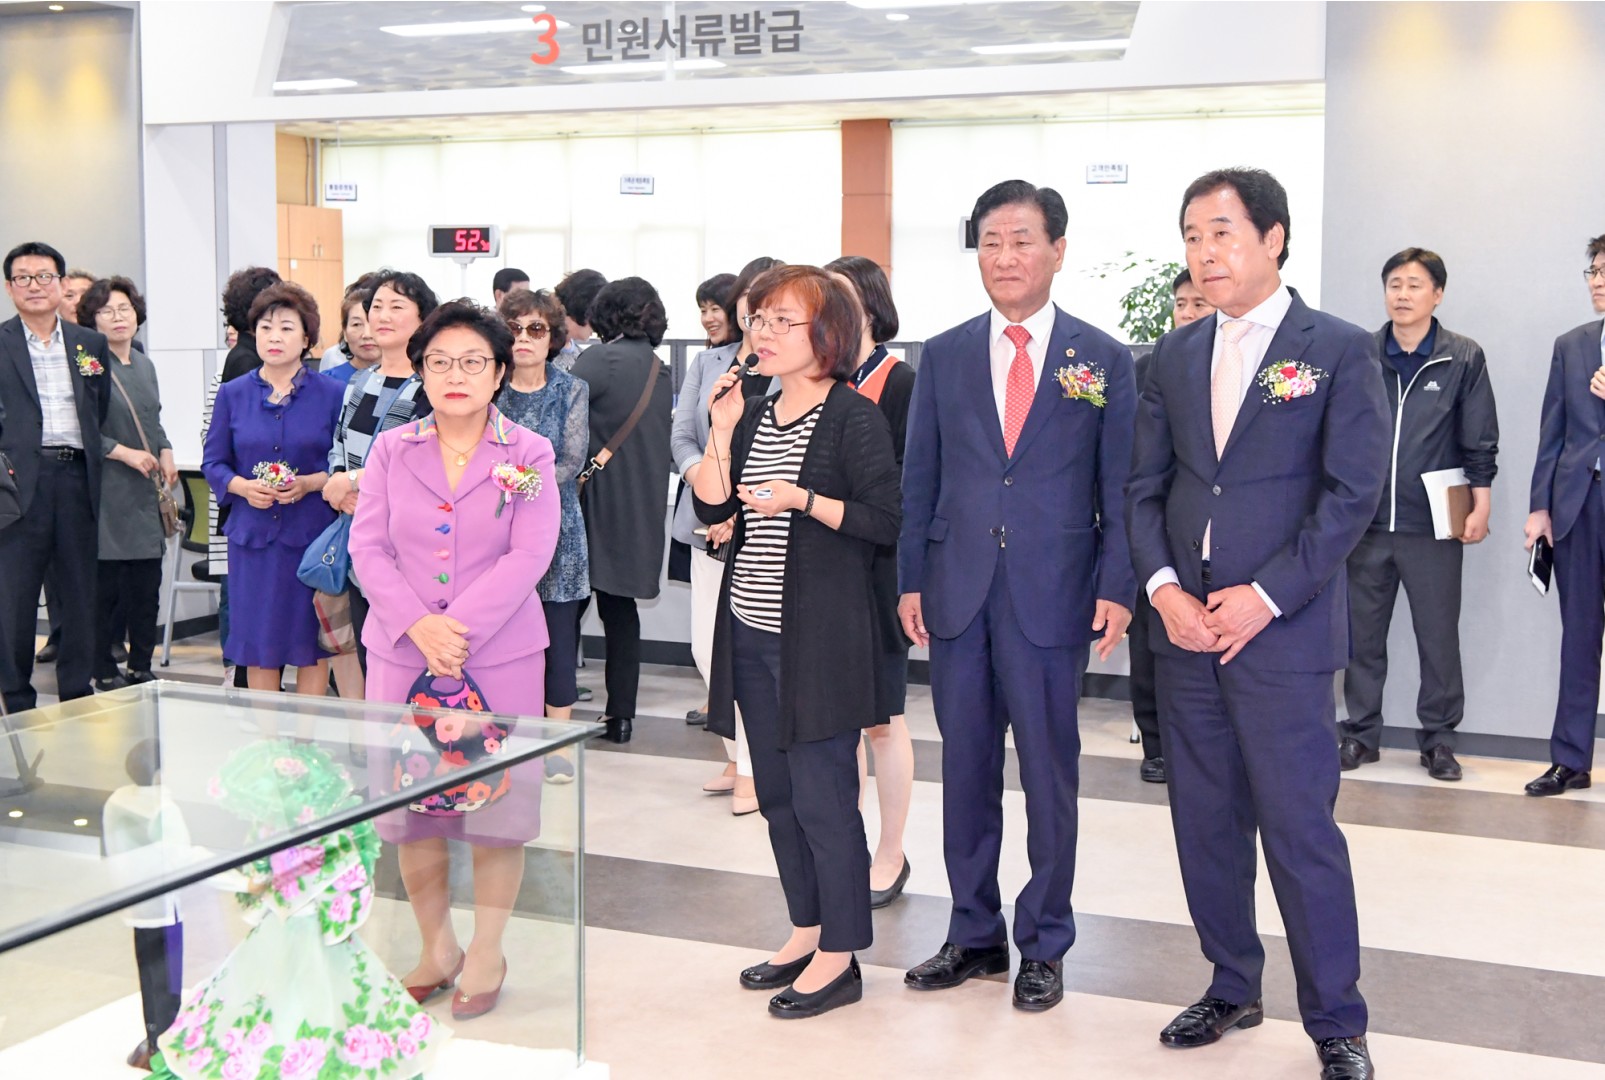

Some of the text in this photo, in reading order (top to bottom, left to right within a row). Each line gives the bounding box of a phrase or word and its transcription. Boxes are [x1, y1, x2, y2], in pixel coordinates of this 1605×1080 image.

[530, 10, 804, 65] 3 민원서류발급
[455, 229, 480, 251] 52
